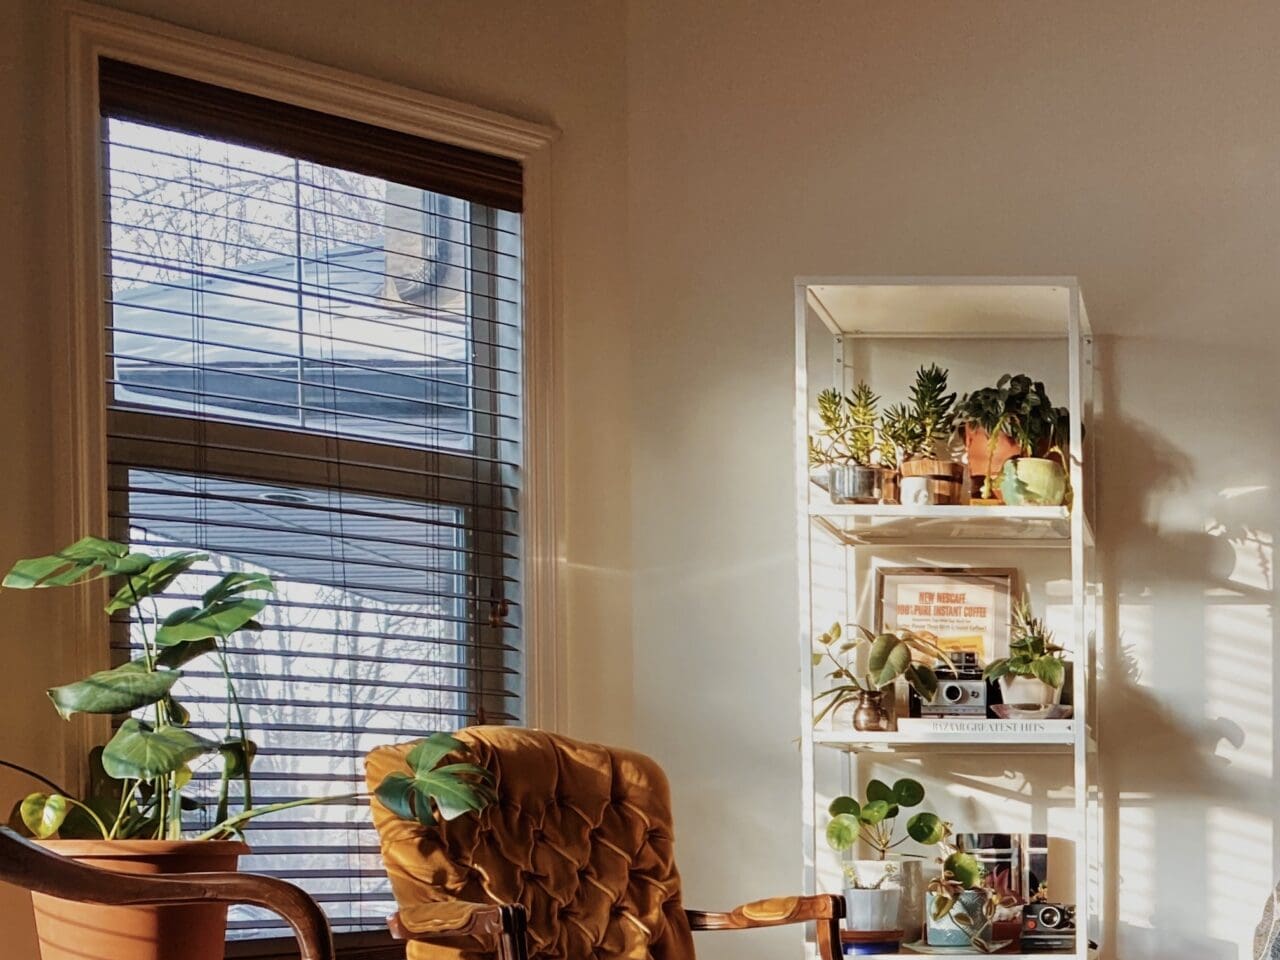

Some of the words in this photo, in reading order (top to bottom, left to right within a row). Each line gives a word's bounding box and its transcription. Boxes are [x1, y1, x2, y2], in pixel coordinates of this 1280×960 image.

[919, 592, 934, 604] NEW
[914, 605, 931, 616] PURE
[934, 606, 962, 617] INSTANT
[964, 606, 987, 618] COFFEE
[966, 722, 1018, 732] GREATEST
[1020, 722, 1046, 732] HITS
